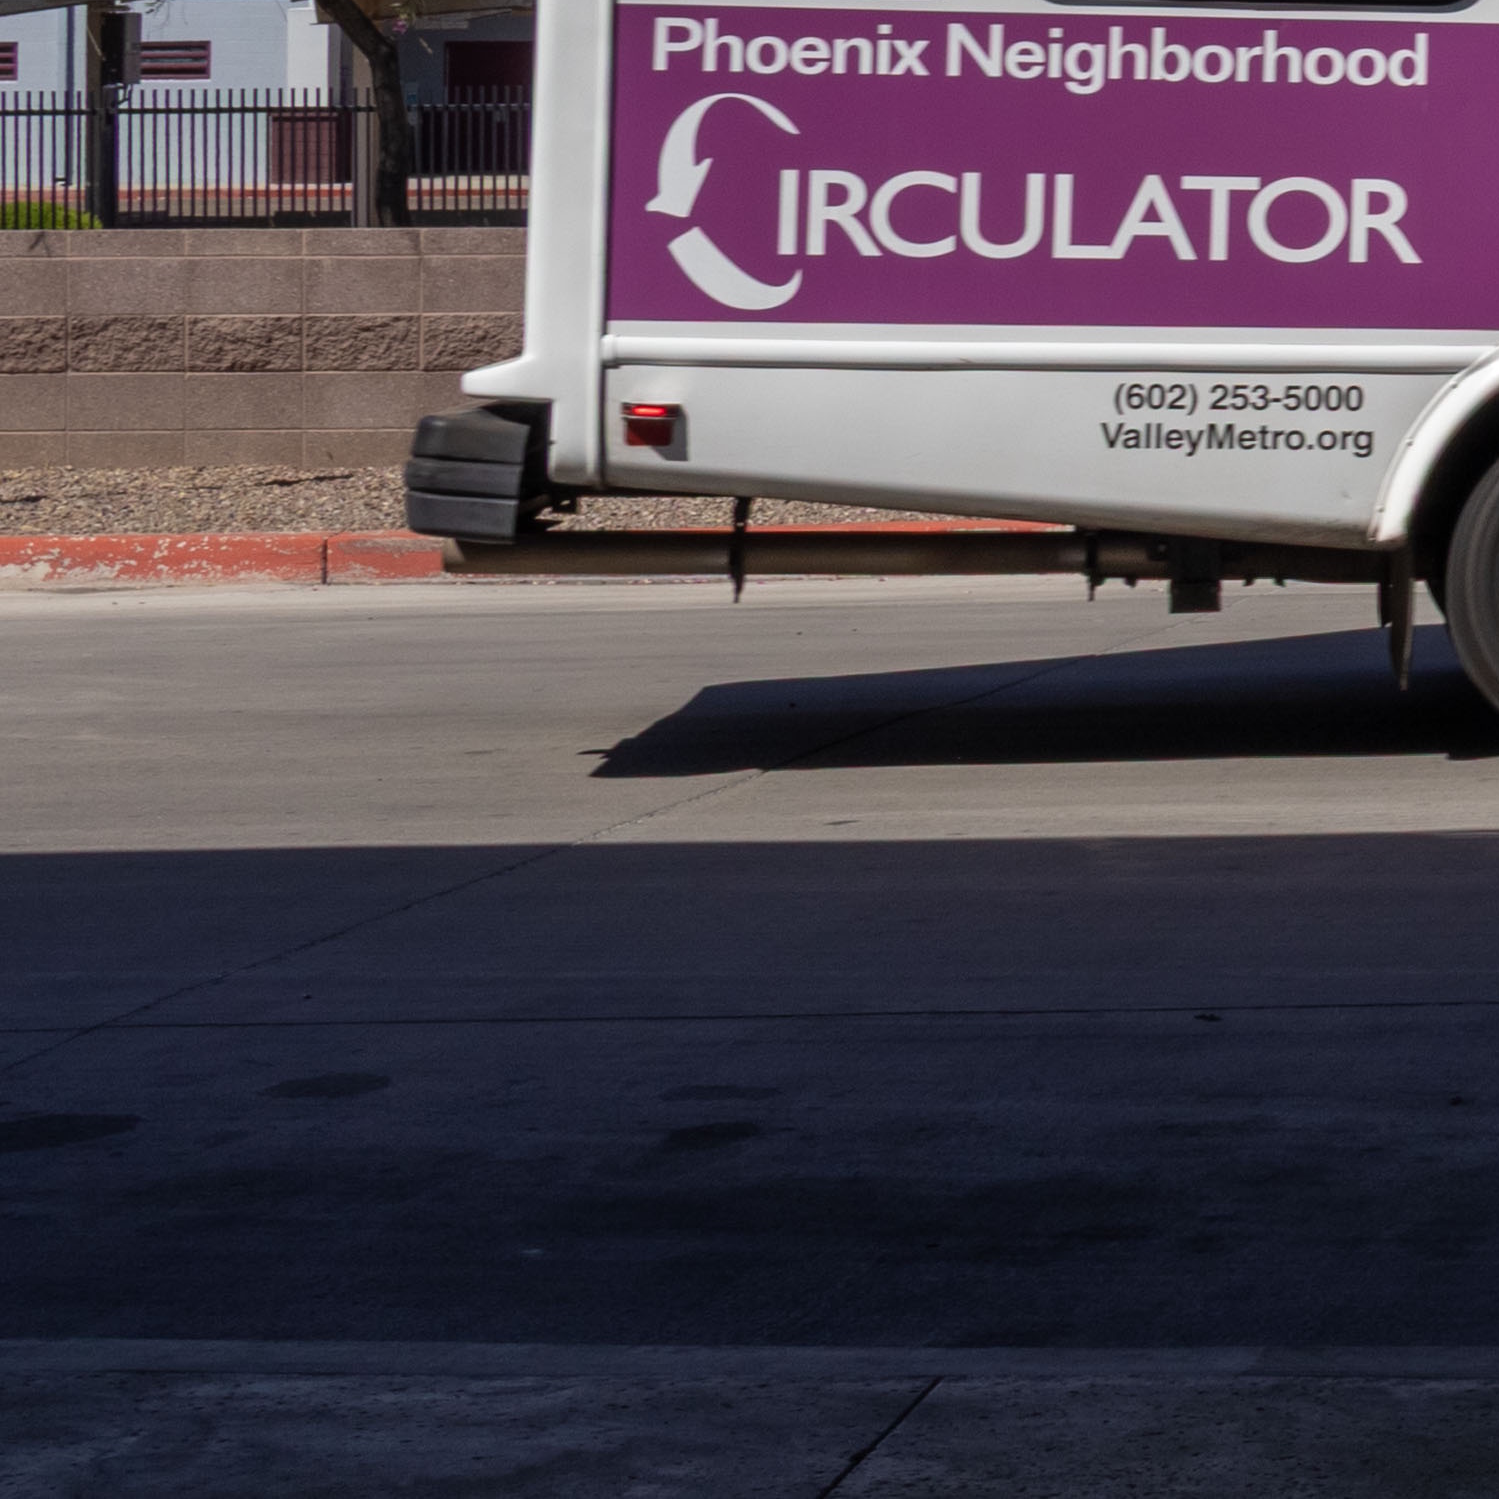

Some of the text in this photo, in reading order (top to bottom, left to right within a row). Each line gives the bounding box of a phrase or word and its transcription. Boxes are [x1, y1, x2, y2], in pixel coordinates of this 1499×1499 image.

[651, 17, 1429, 94] Phoenix Neighborhood
[1114, 383, 1364, 414] (602) 253-5000
[1100, 422, 1375, 458] ValleyMetro.org
